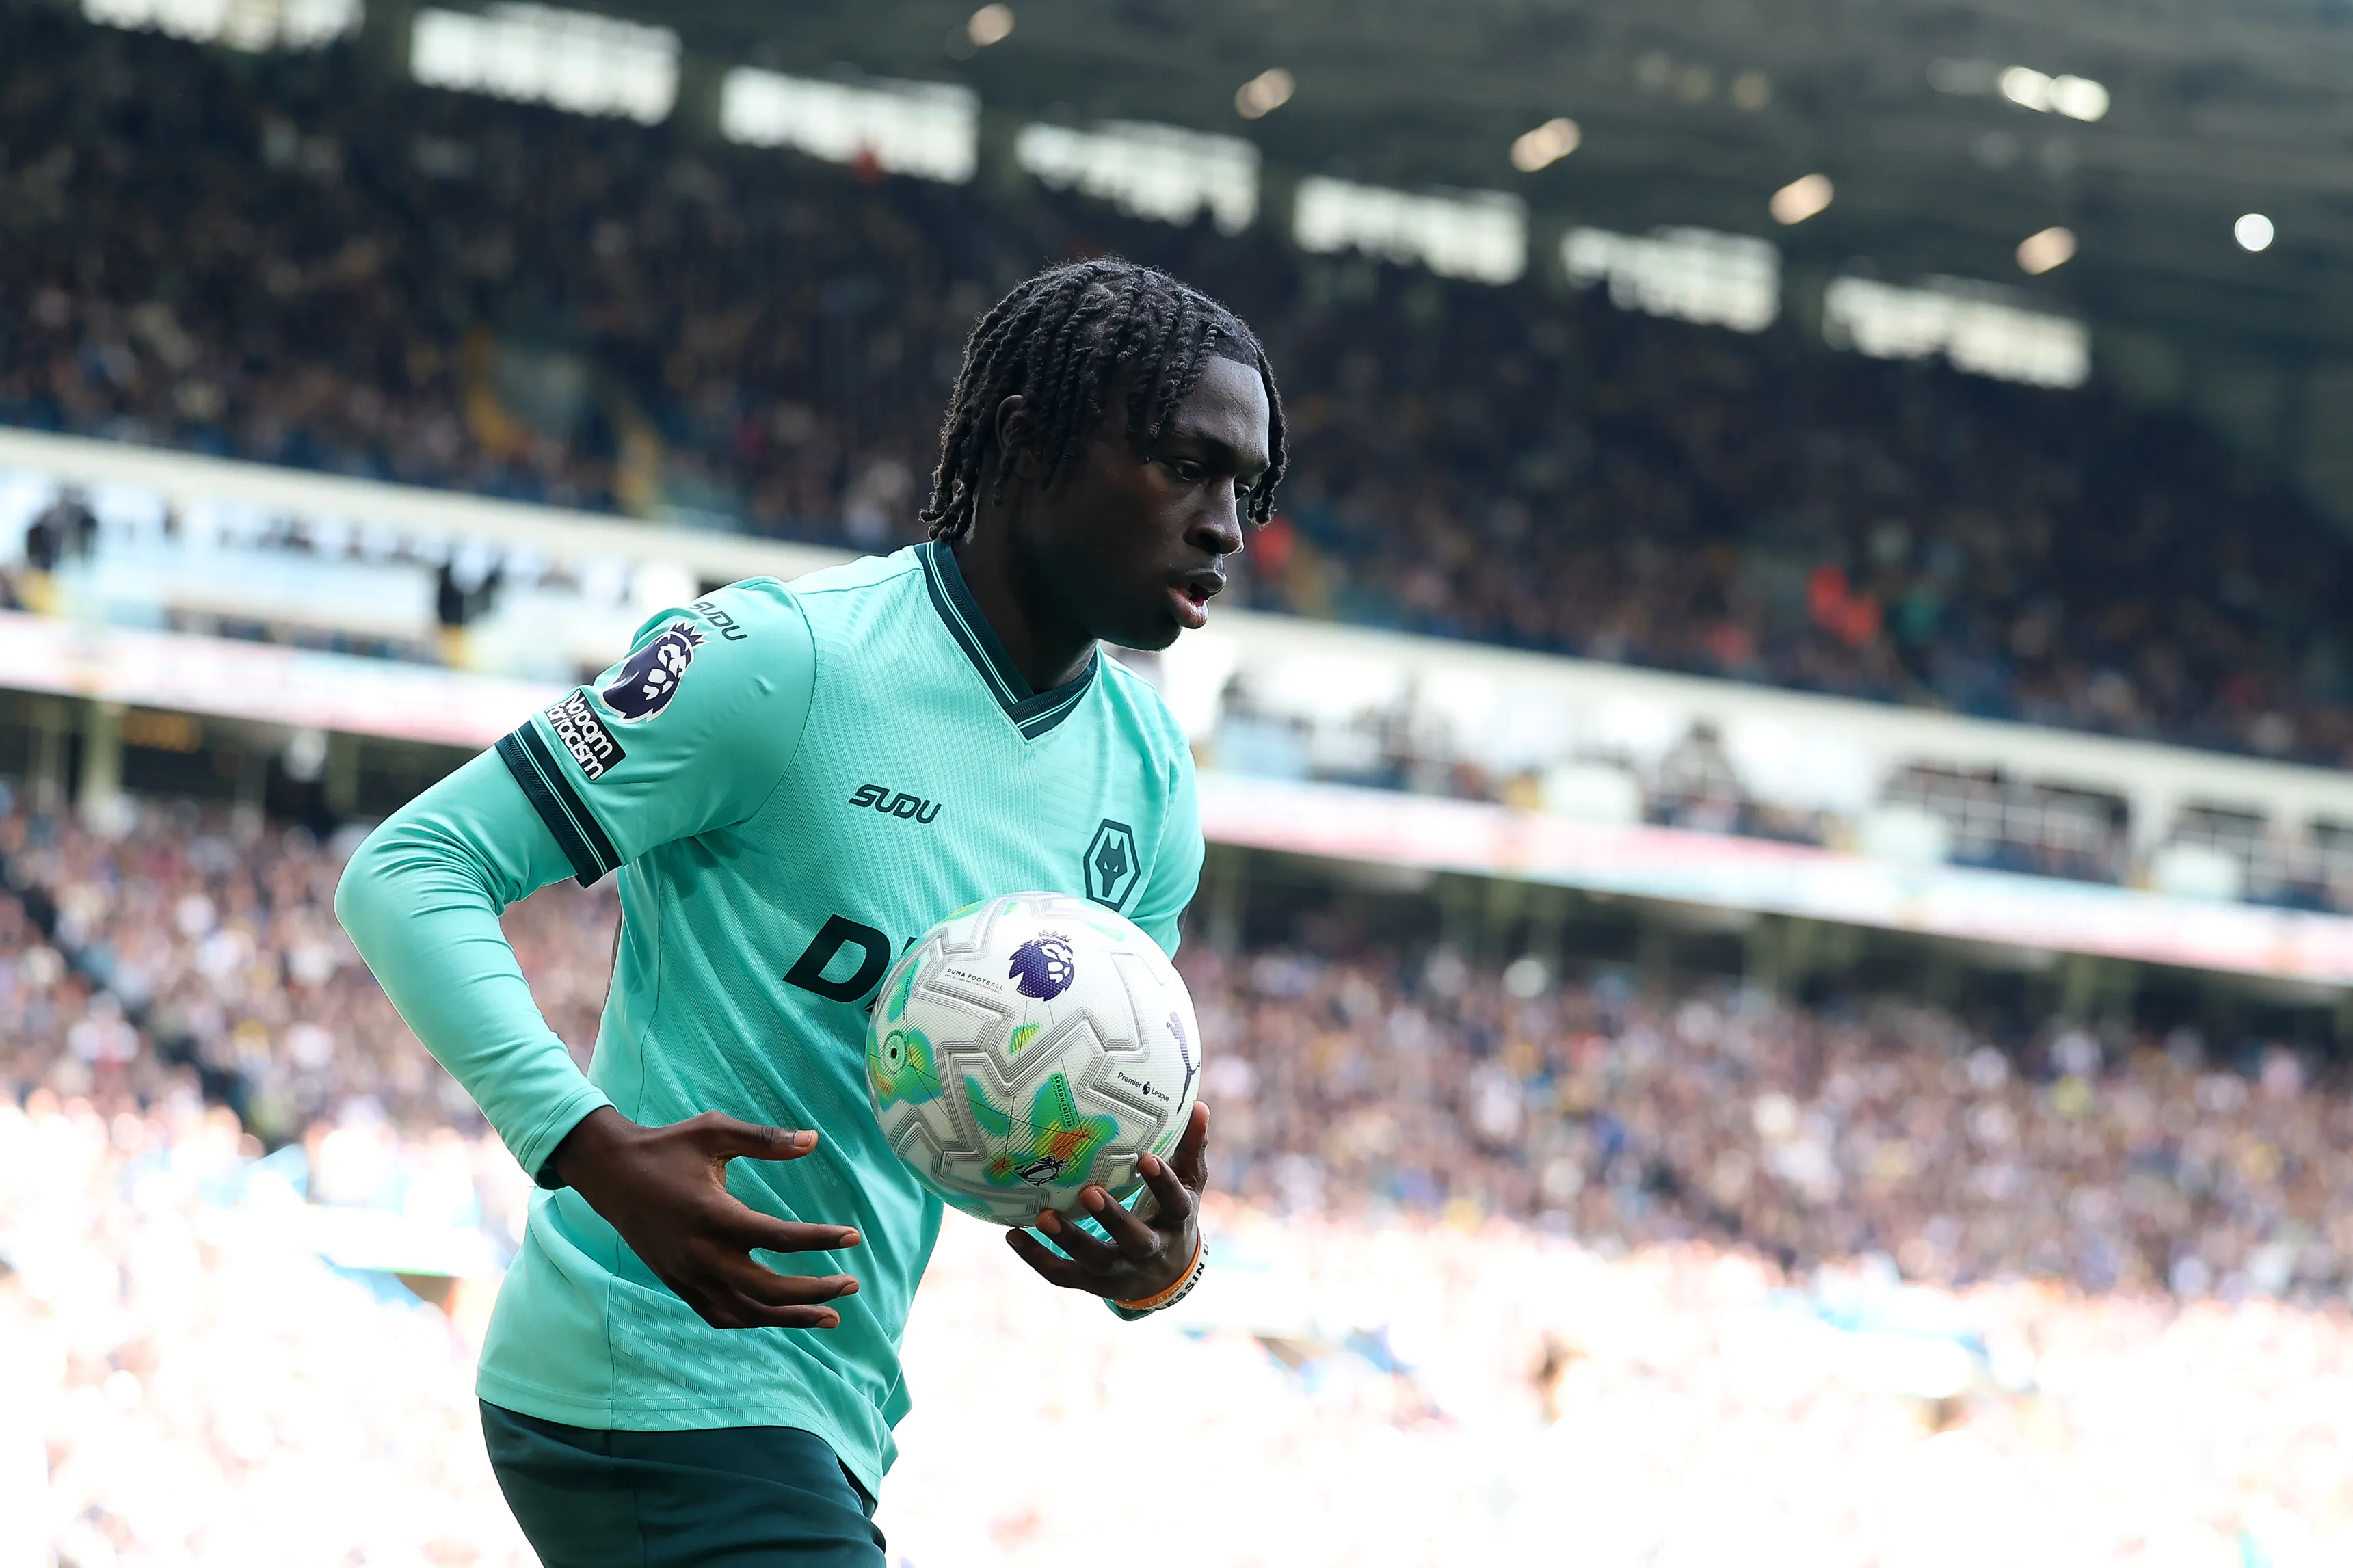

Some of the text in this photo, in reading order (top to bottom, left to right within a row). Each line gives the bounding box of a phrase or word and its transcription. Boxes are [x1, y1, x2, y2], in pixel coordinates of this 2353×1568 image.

[689, 602, 748, 641] SUDU
[564, 689, 613, 760] No room
[553, 718, 604, 780] racism
[849, 784, 942, 824] SUDU
[782, 914, 917, 1013] D
[947, 968, 966, 977] PUMA
[967, 974, 1003, 991] FOOTBALL
[1054, 1076, 1065, 1102] SEASON
[1061, 1103, 1072, 1128] 2025/26
[1117, 1072, 1169, 1102] Premier League
